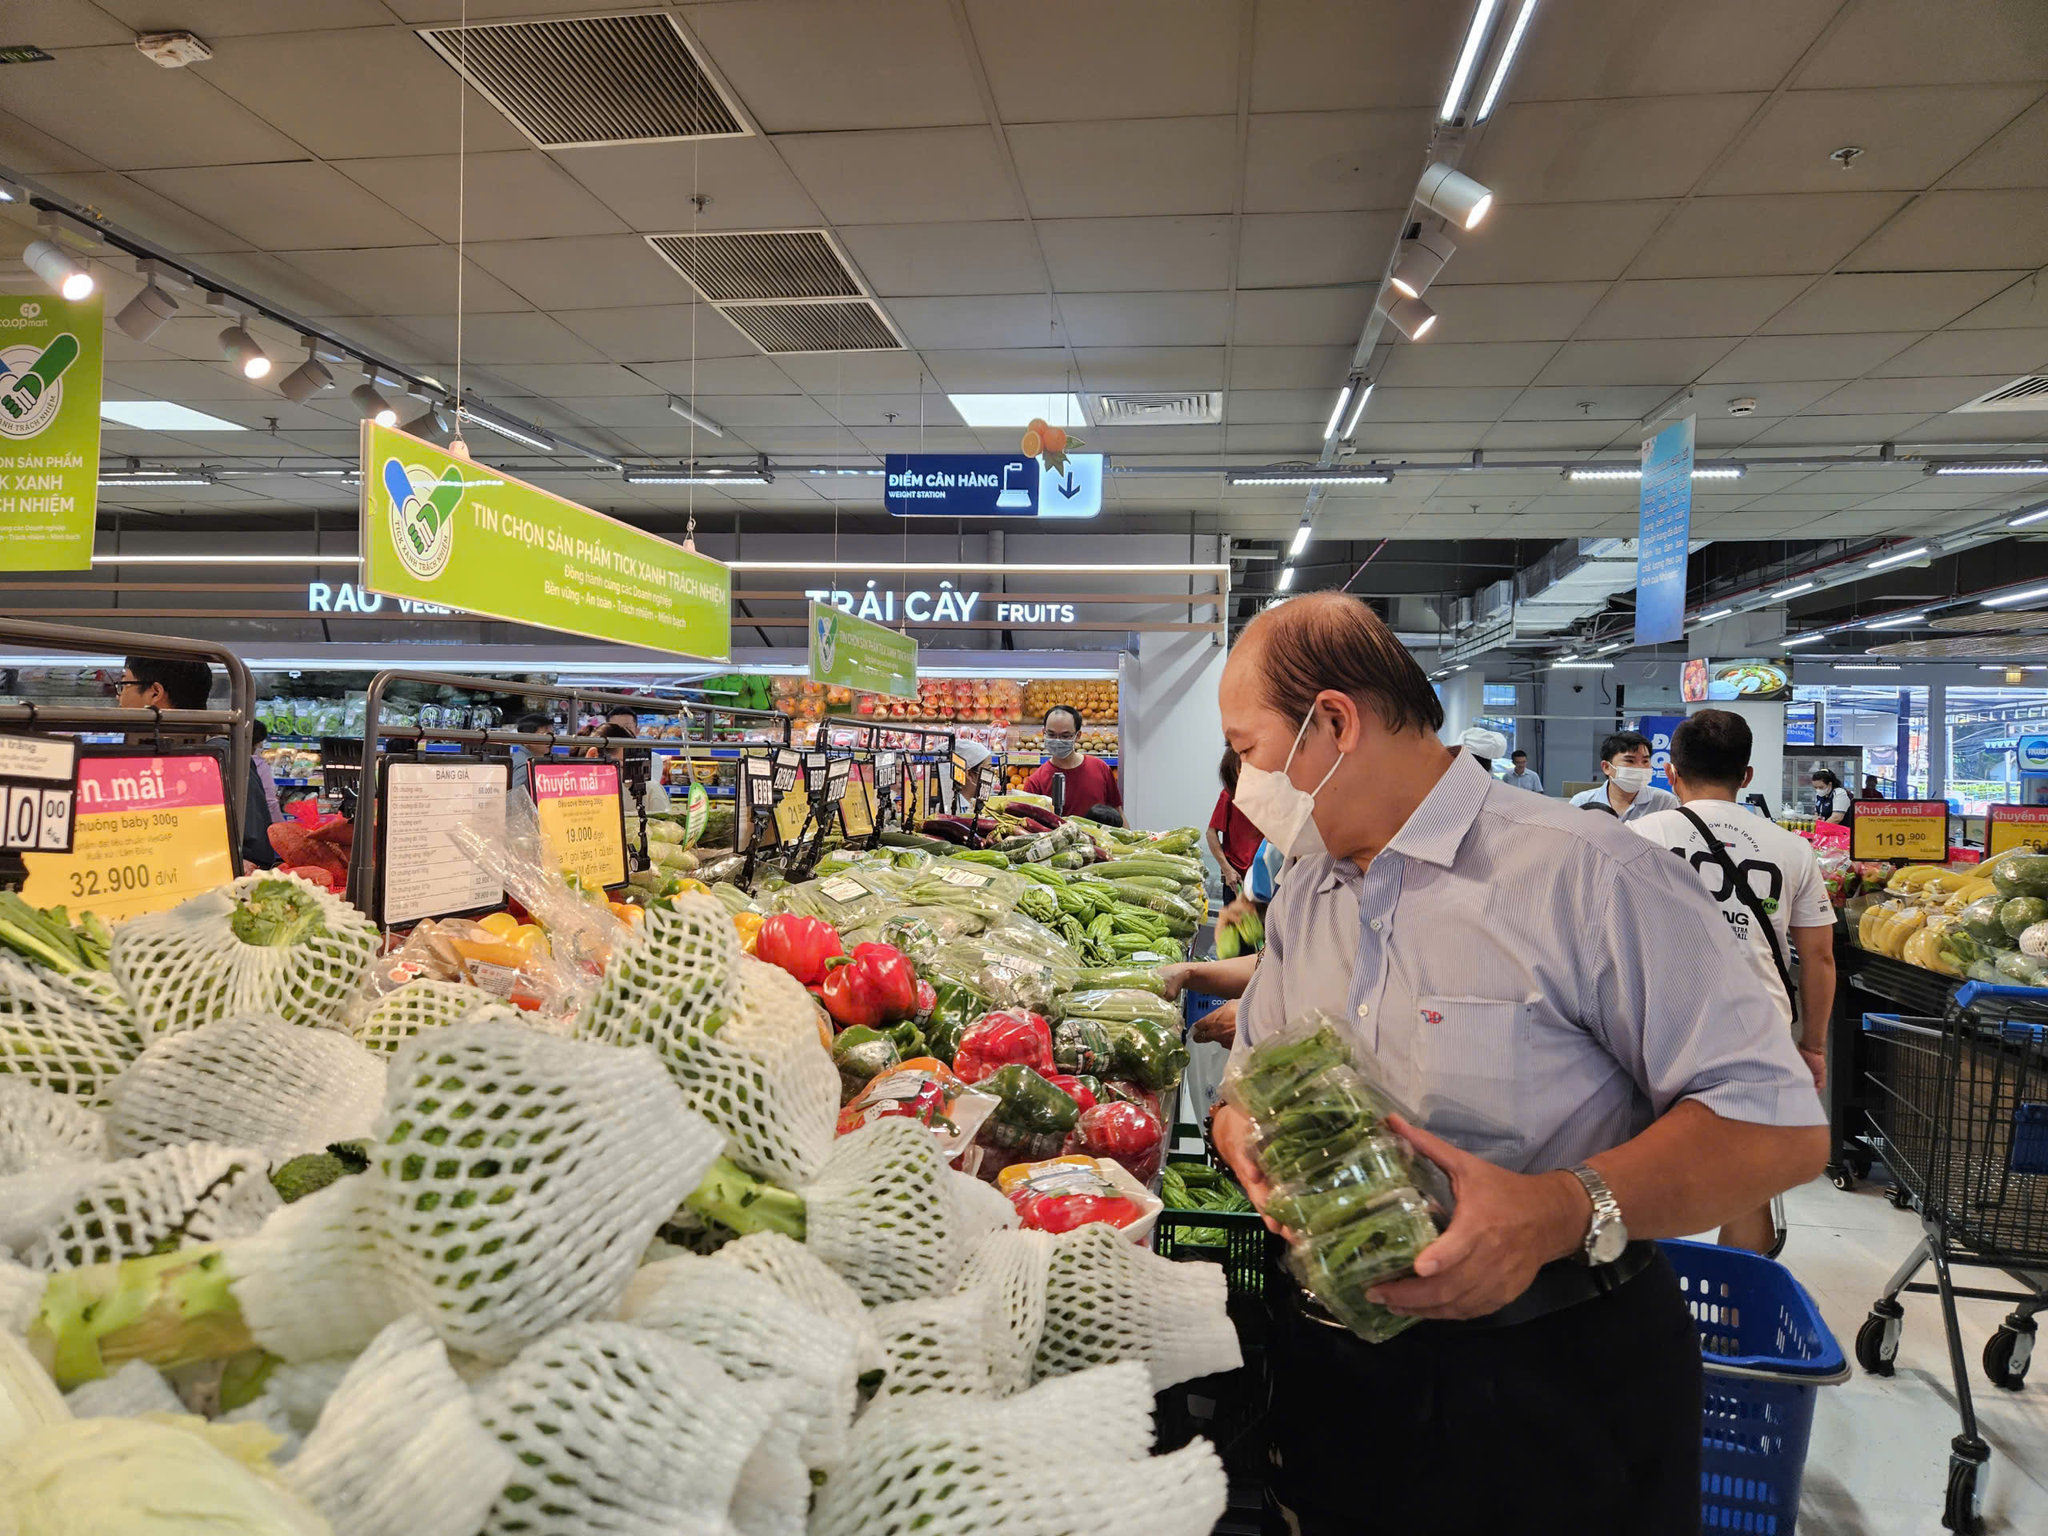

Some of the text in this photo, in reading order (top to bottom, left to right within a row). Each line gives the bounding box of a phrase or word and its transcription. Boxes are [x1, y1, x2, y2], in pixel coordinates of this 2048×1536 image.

[17, 453, 43, 469] SẢN
[15, 474, 63, 490] XANH
[889, 470, 998, 487] ĐIỂM CÂN HÀNG
[20, 493, 75, 517] NHIỆM
[472, 502, 726, 607] TIN CHỌN SẢN PHẨM TICK XANH TRÁCH NHIỆM
[564, 564, 585, 584] Đồng
[585, 570, 602, 586] hành
[604, 578, 621, 595] cùng
[621, 582, 633, 596] các
[633, 584, 653, 601] Doanh
[545, 580, 560, 597] Bền
[561, 587, 580, 604] vững
[586, 592, 597, 605] An
[597, 597, 612, 609] toàn
[617, 600, 635, 614] Trách
[905, 580, 980, 623] CÂY
[997, 604, 1075, 623] FRUITS
[436, 769, 470, 780] BẢNG GIÁ
[536, 771, 598, 796] Khuyến mãi
[111, 769, 166, 801] mãi
[1855, 804, 1922, 817] Khuyến mãi
[1993, 810, 2048, 822] Khuyến m
[121, 816, 149, 830] baby
[153, 813, 178, 828] 300g
[566, 826, 593, 843] 19.000
[1724, 823, 1739, 832] the
[1741, 830, 1760, 853] leaves
[1876, 833, 1905, 846] 119
[70, 864, 150, 898] 32.900
[1670, 847, 1783, 906] 00
[1762, 901, 1777, 911] KM
